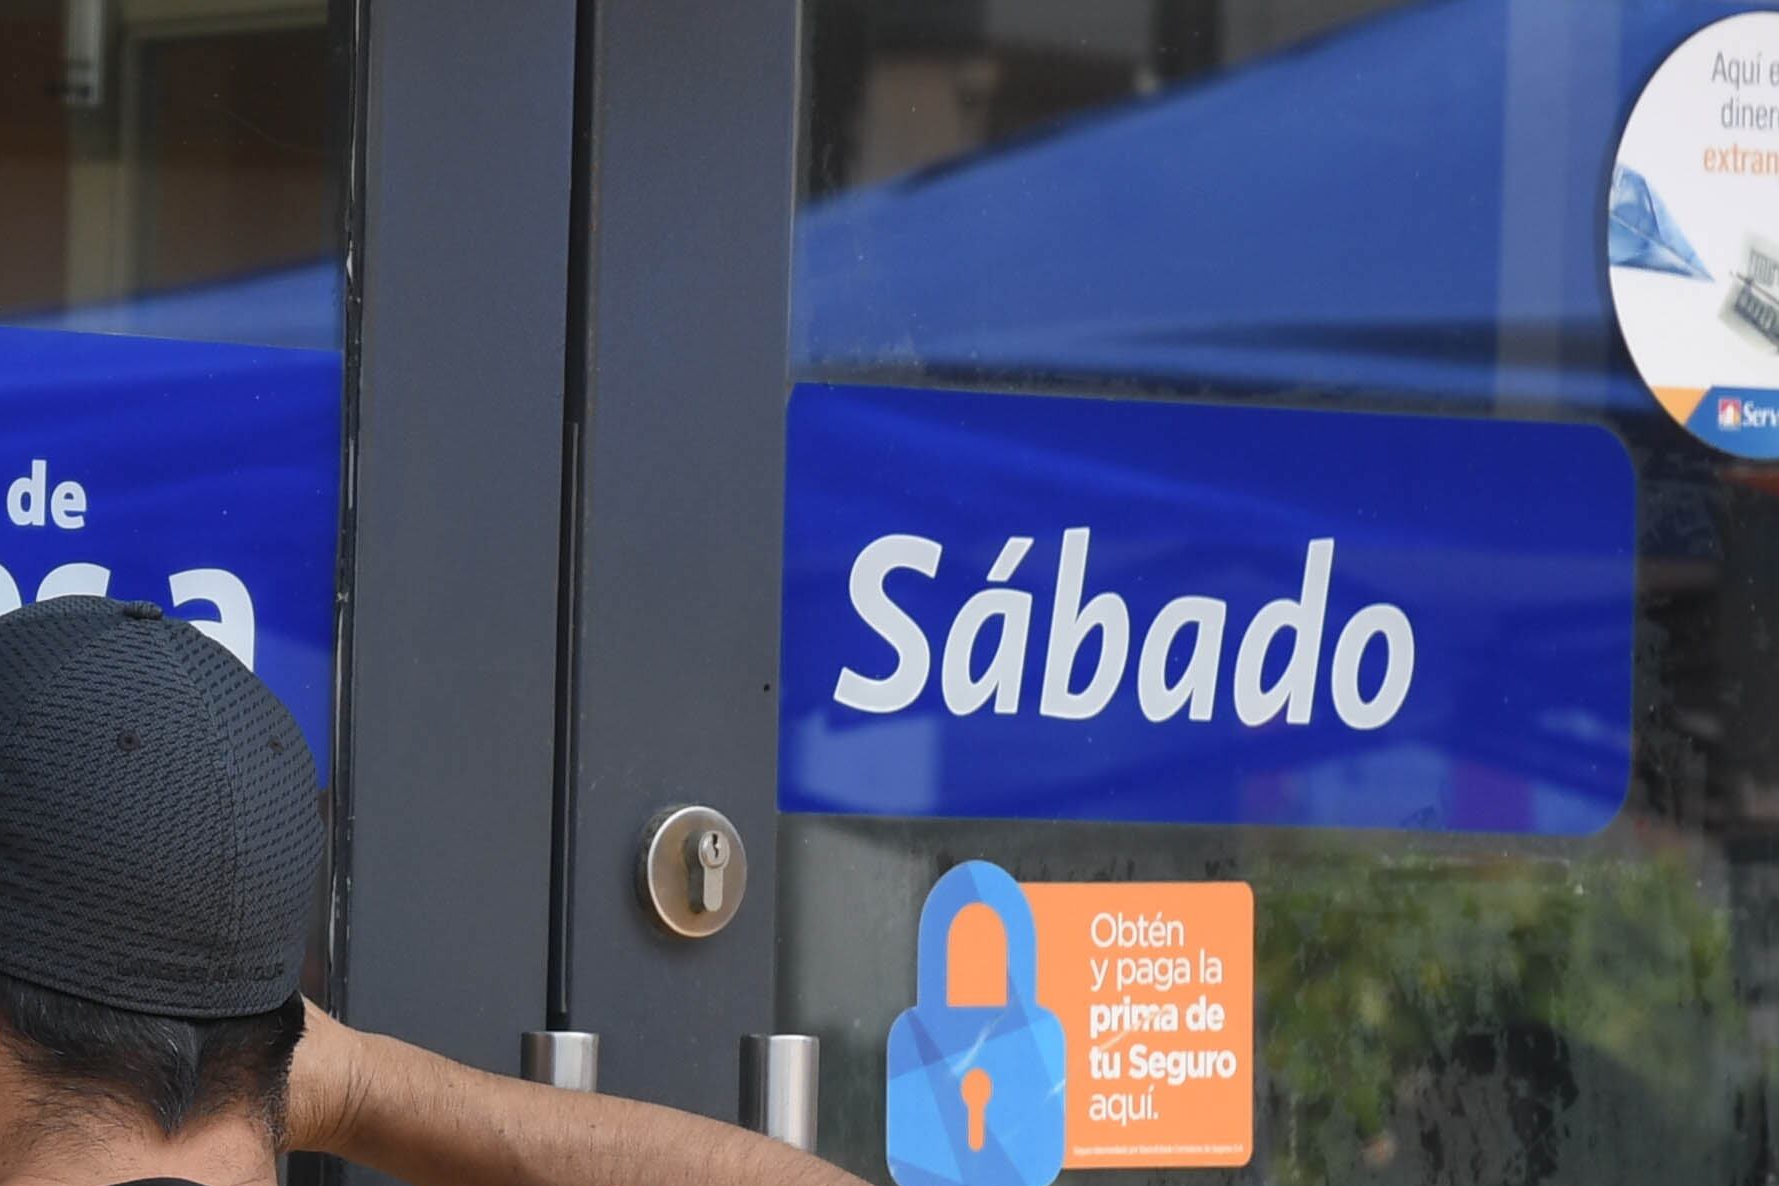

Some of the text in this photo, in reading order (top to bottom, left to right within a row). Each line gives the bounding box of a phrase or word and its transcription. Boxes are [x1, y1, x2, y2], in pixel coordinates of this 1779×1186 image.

[1711, 50, 1763, 91] Aquí
[1720, 95, 1779, 129] diner
[6, 458, 87, 530] de
[832, 526, 1416, 731] Sábado
[1090, 911, 1184, 949] Obtén
[1089, 948, 1223, 992] y paga la
[1089, 994, 1226, 1038] prima de
[1088, 1044, 1237, 1085] tu Seguro
[1088, 1085, 1159, 1126] aquí.
